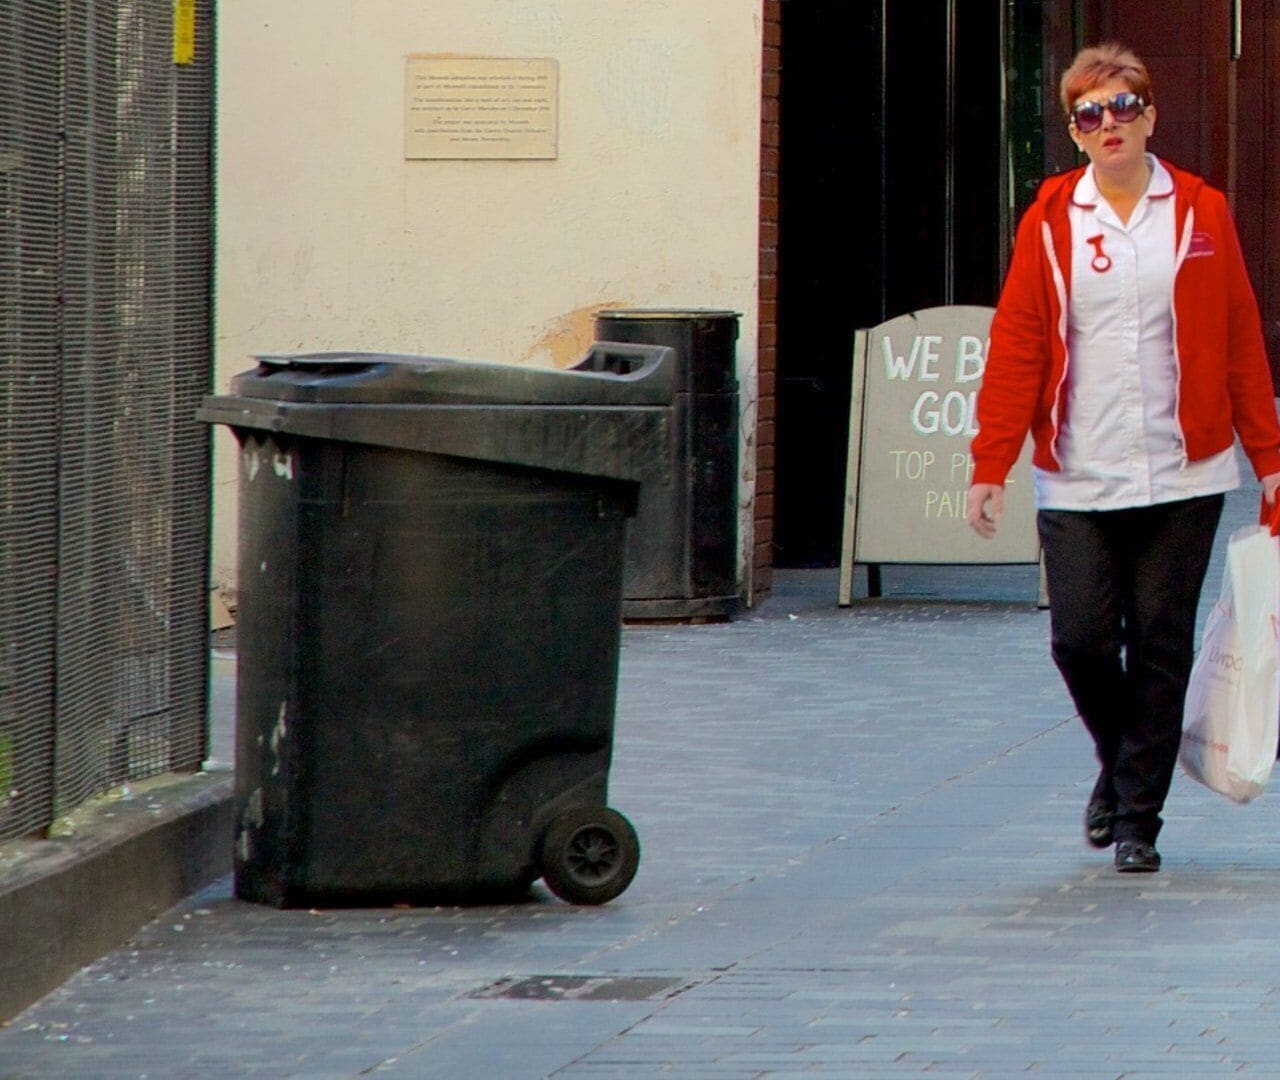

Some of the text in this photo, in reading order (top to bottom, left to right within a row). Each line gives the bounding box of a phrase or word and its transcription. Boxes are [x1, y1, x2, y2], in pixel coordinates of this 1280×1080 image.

[882, 335, 942, 383] WE
[912, 390, 980, 436] GOL
[889, 450, 935, 480] TOP
